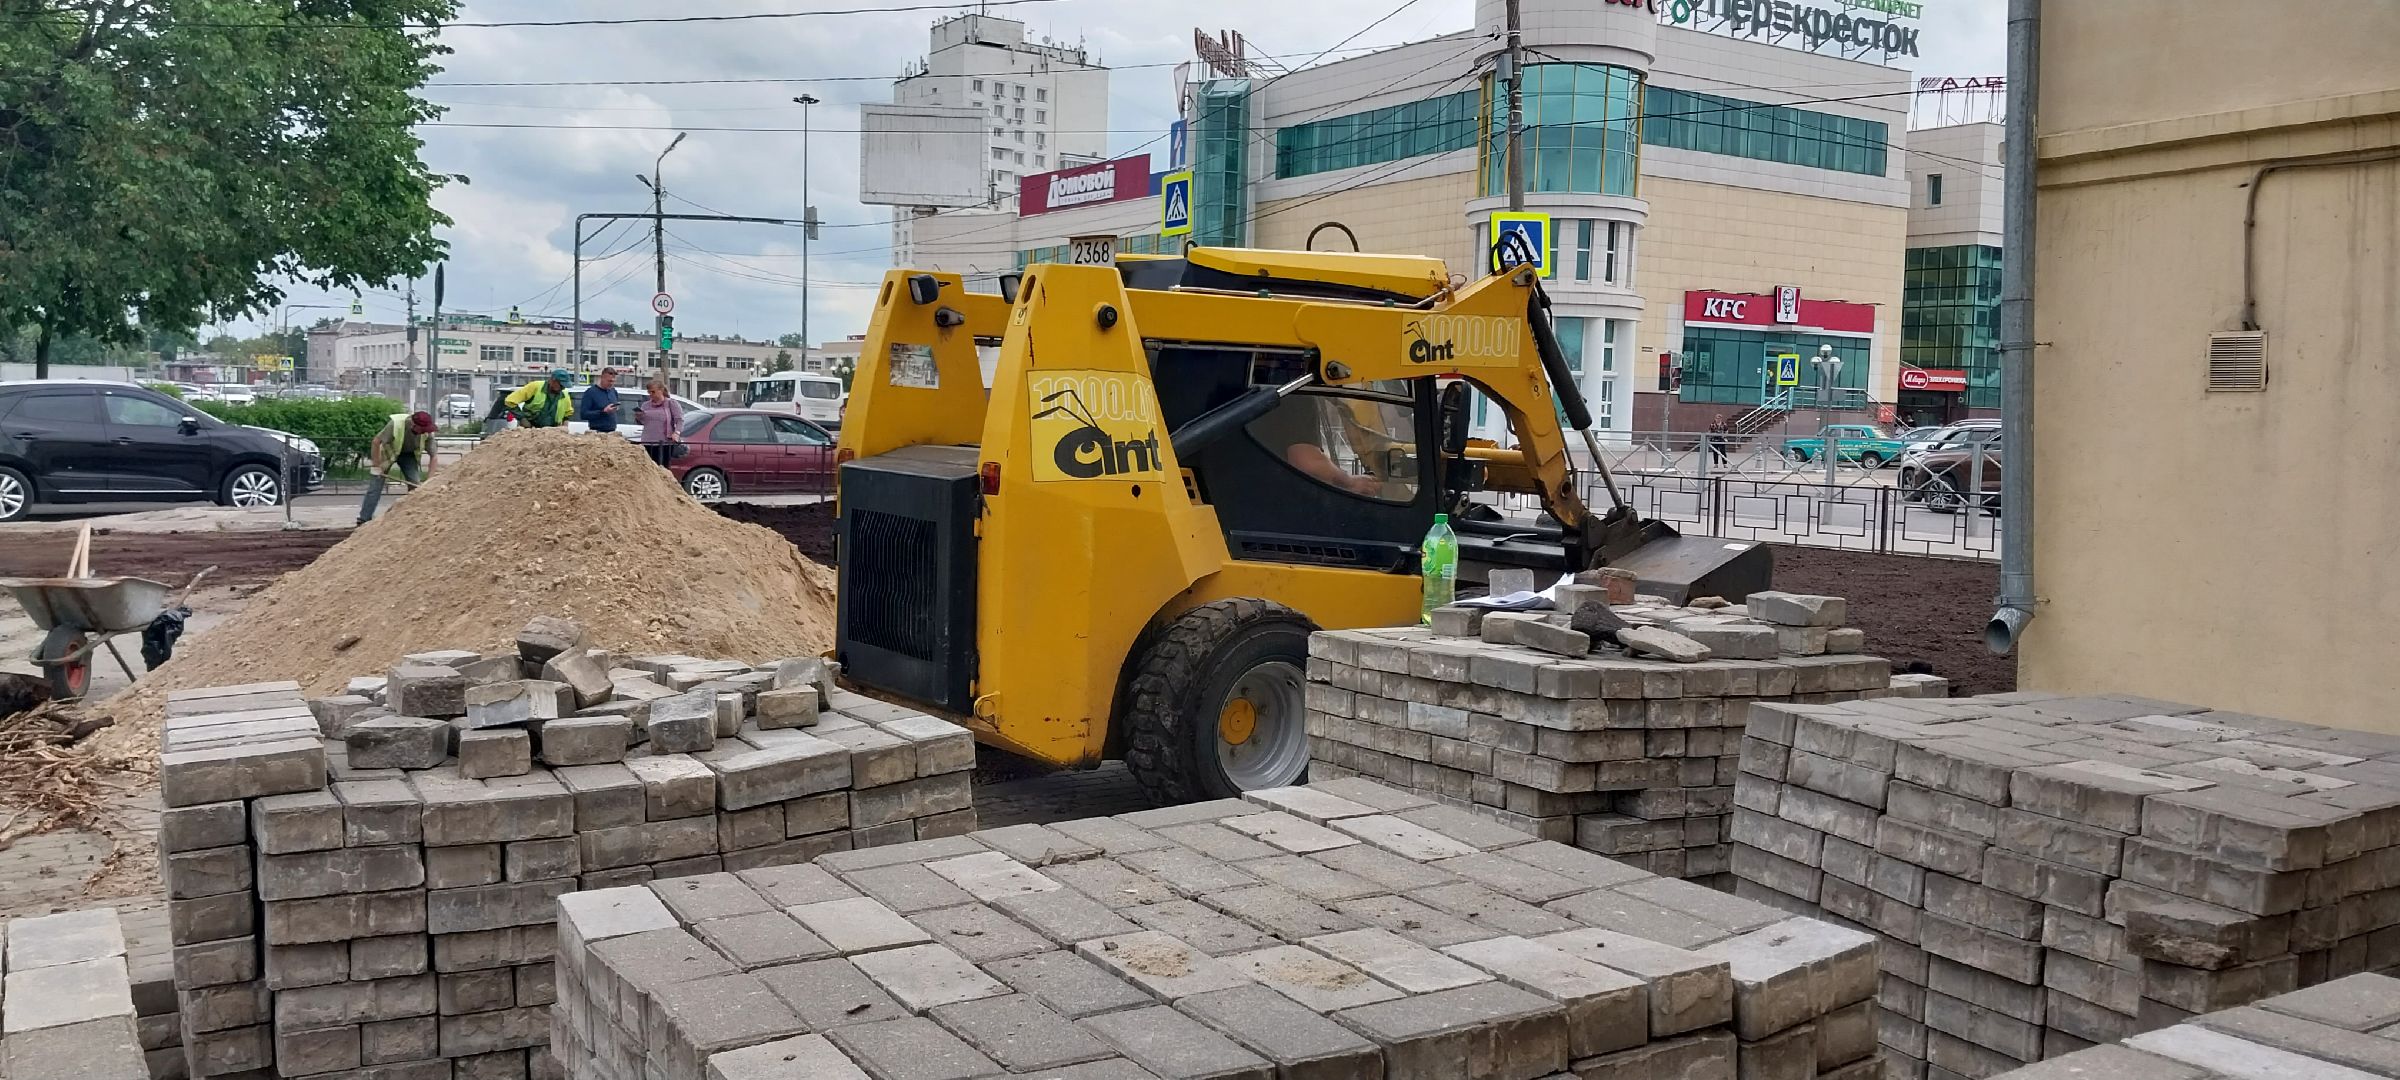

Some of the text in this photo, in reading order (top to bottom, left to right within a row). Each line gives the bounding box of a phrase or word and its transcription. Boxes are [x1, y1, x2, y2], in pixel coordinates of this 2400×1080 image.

[1074, 241, 1110, 264] 2368
[657, 299, 669, 308] 40
[1703, 297, 1747, 319] KFC
[1421, 314, 1521, 357] 1000.01
